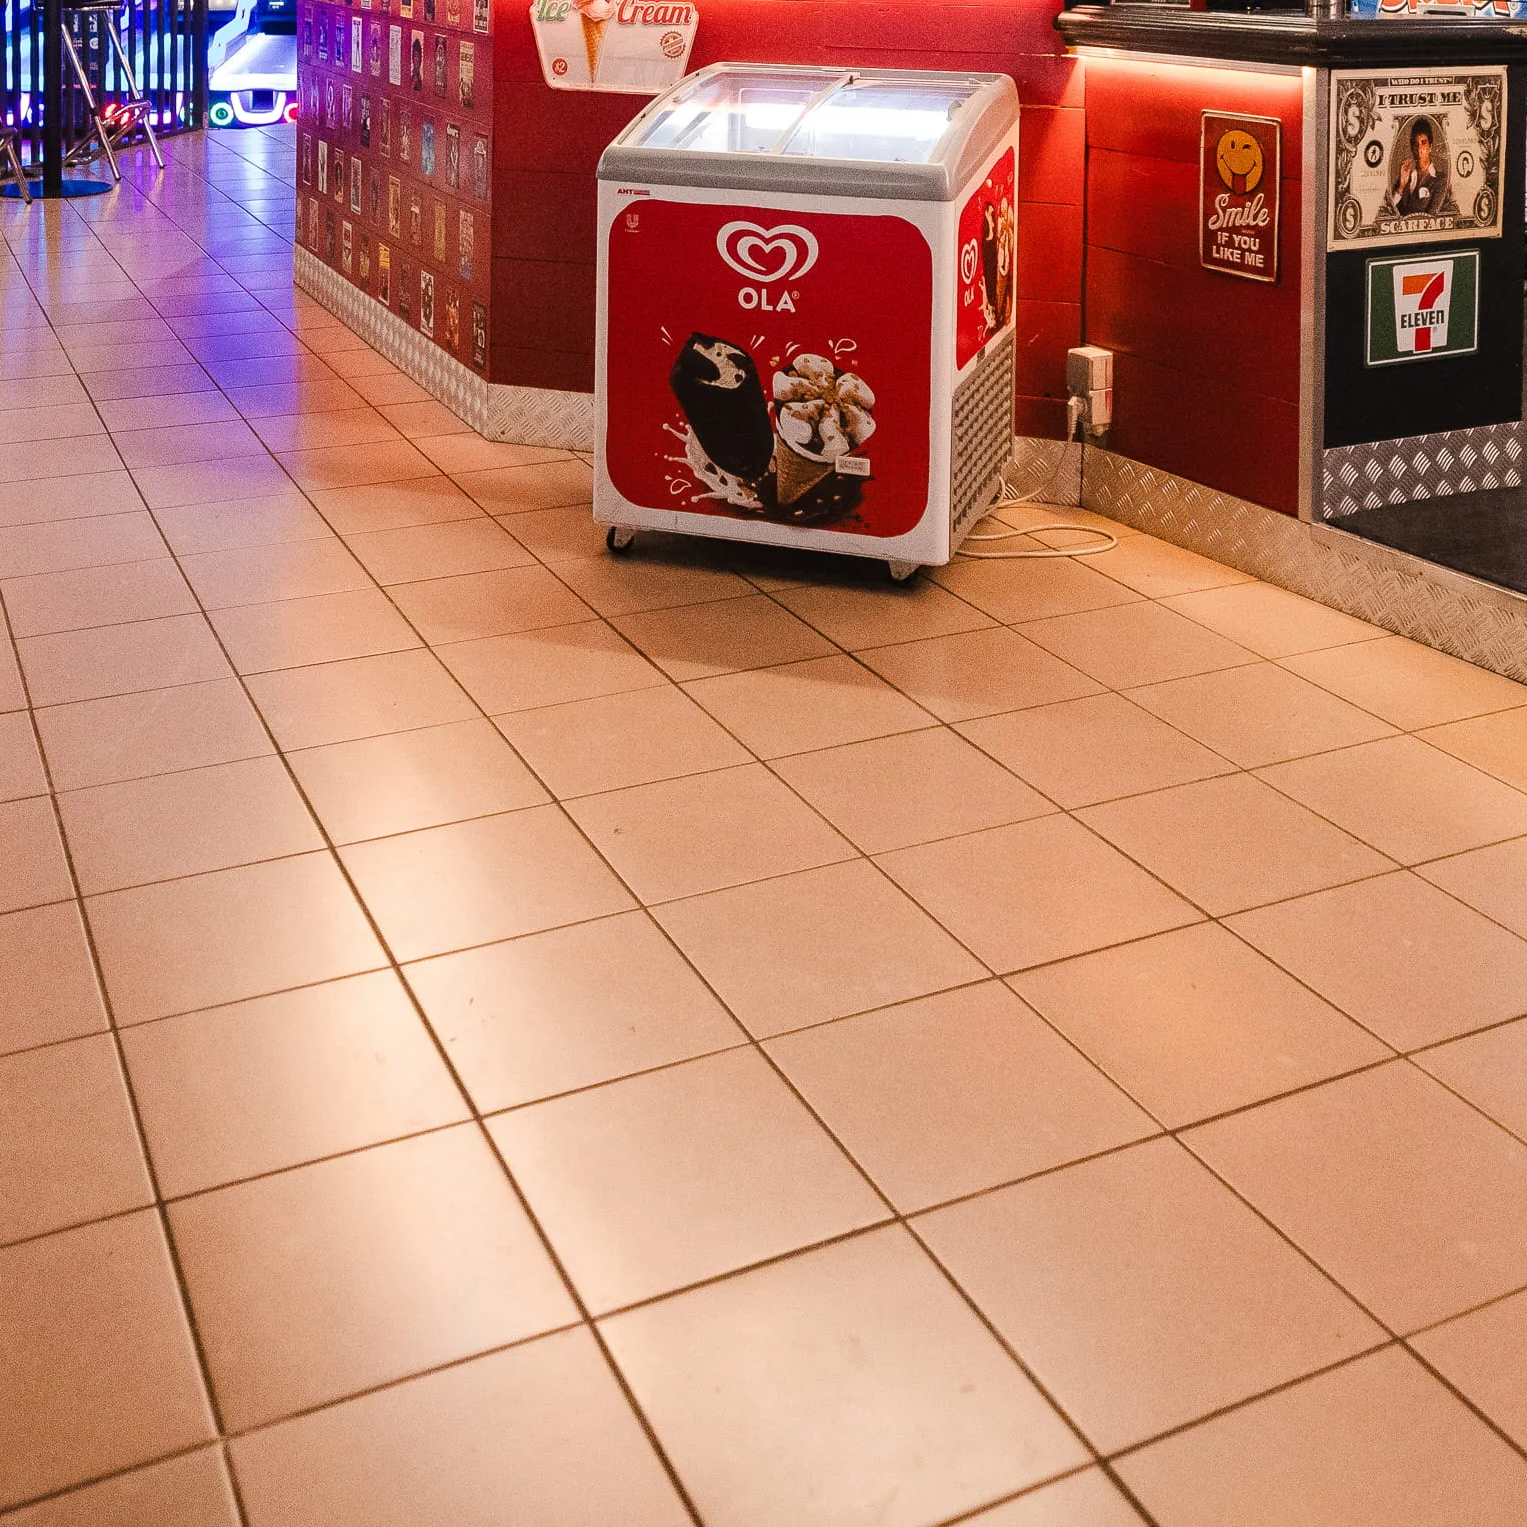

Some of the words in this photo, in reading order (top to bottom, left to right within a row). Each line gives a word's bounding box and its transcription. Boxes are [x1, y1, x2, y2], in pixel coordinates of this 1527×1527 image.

[1378, 94, 1387, 107] I
[1389, 92, 1437, 107] TRUST
[1440, 91, 1462, 105] ME
[1208, 192, 1270, 230] Smile
[1381, 217, 1454, 234] SCARFACE
[1217, 231, 1229, 244] IF
[1232, 233, 1260, 251] YOU
[1212, 244, 1241, 264] LIKE
[1244, 249, 1264, 268] ME
[738, 287, 796, 313] OLA
